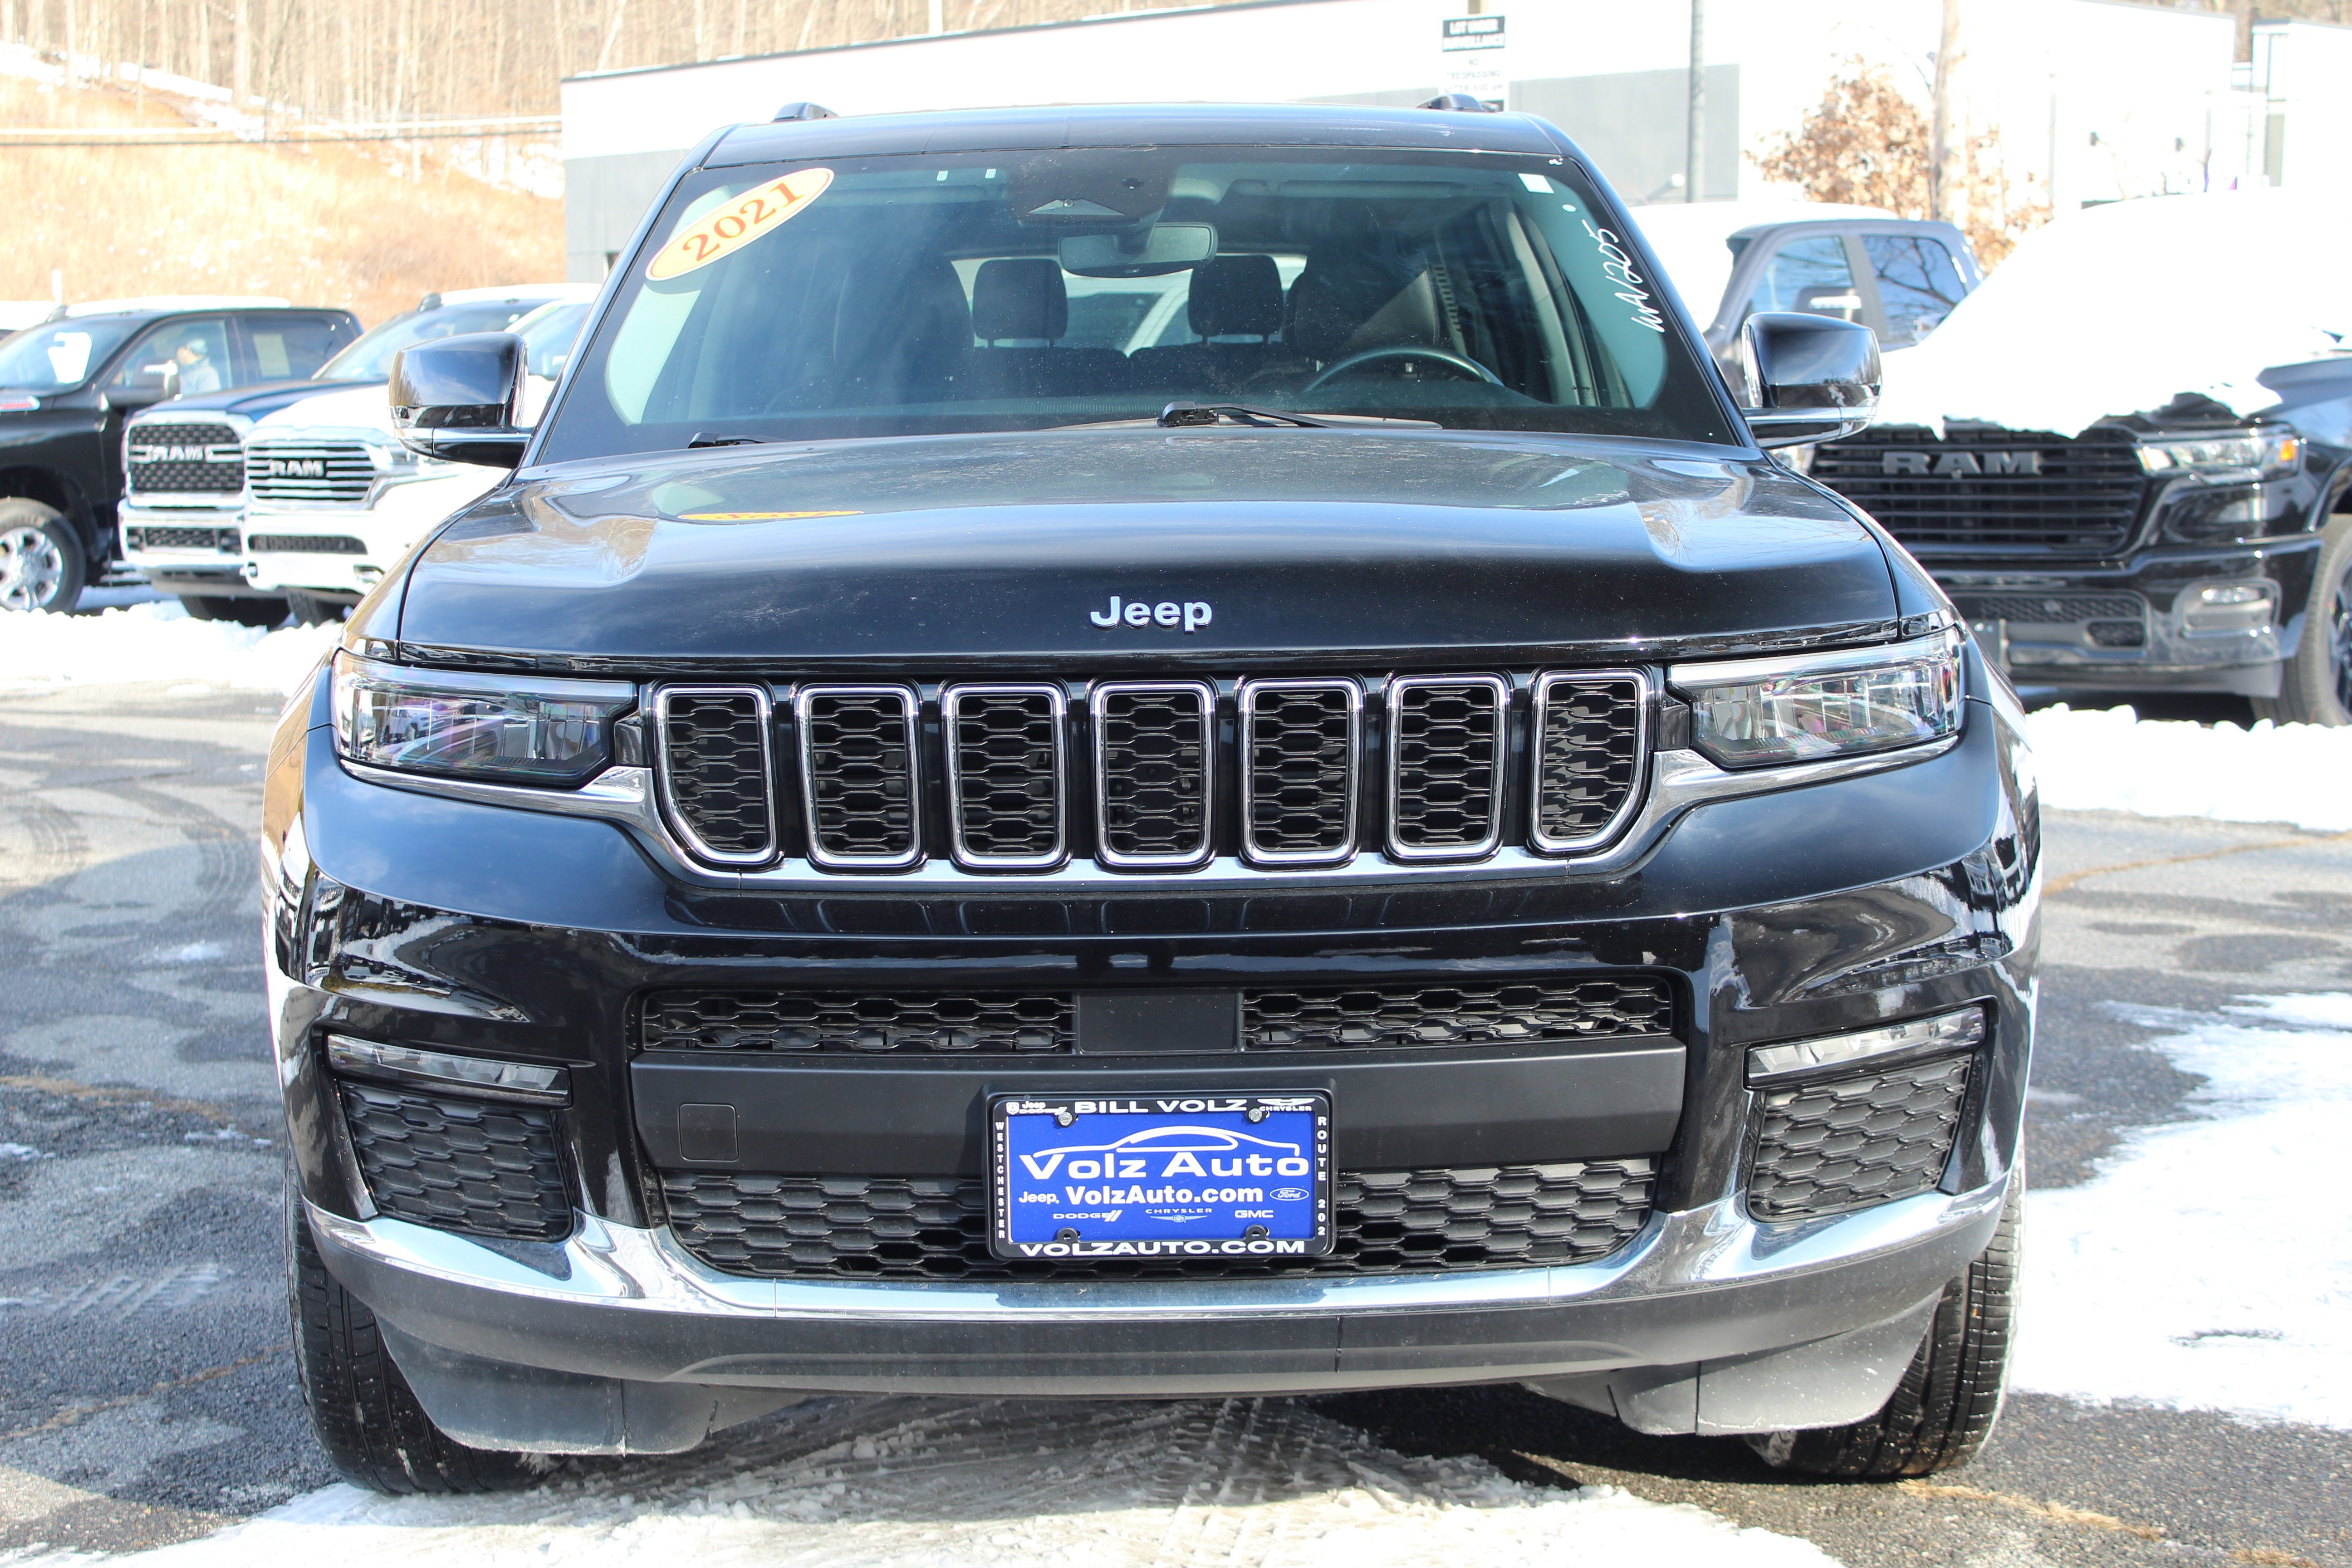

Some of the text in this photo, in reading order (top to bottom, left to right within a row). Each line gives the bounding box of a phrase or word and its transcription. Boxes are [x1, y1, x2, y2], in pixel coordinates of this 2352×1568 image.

[682, 182, 804, 262] 2021
[152, 446, 204, 461] RAM
[1882, 451, 2041, 475] RAM
[269, 460, 324, 476] RAM
[1090, 596, 1213, 633] Jeep
[1074, 1099, 1247, 1114] BILL VOLZ
[1019, 1152, 1309, 1180] Volz Auto
[1317, 1116, 1328, 1236] ROUTE 202
[995, 1121, 1006, 1239] WESTCHESTER
[1065, 1185, 1264, 1205] VolzAuto.com
[1234, 1209, 1274, 1219] GMC
[1019, 1240, 1305, 1256] VOLZAUTO.COM
